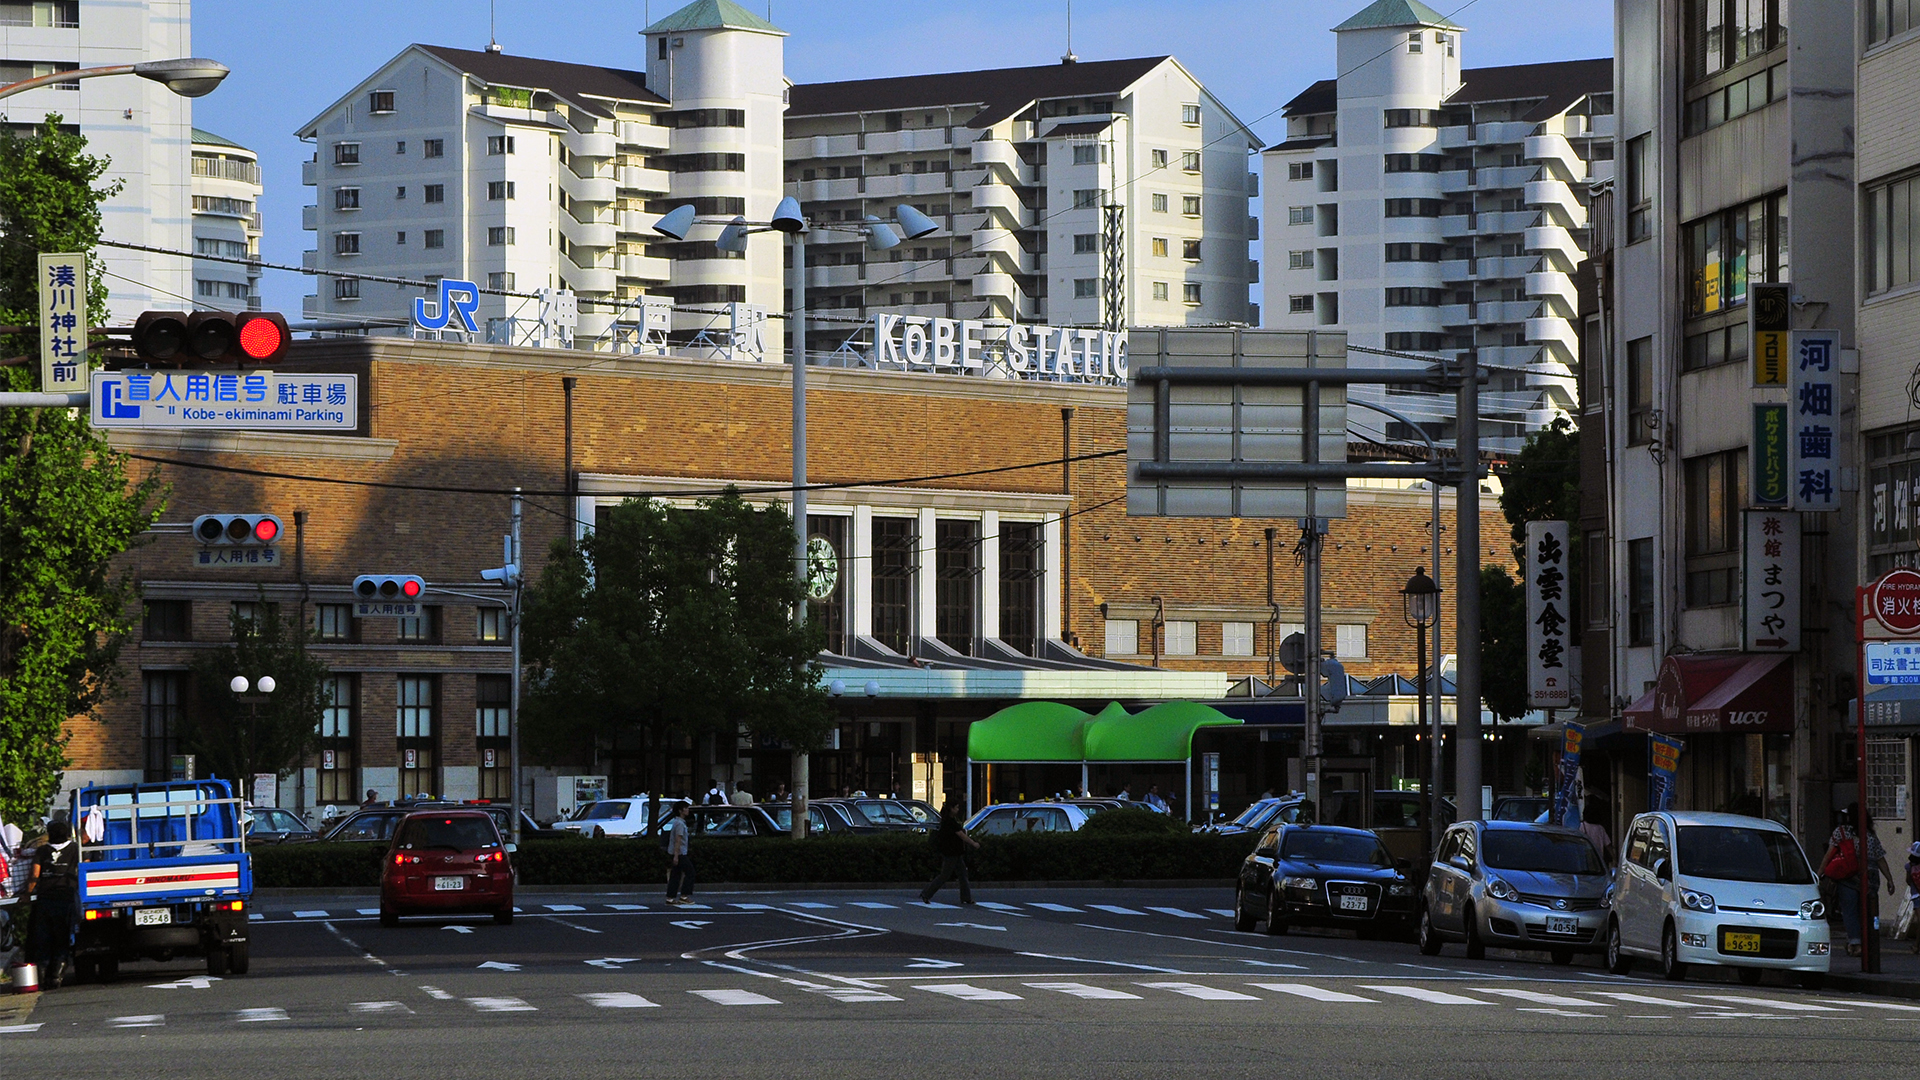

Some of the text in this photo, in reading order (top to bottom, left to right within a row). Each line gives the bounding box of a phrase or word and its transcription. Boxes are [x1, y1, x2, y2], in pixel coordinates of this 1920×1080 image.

[414, 279, 480, 333] JR
[48, 264, 78, 382] 湊川神社前
[539, 287, 767, 354] 神戸駅
[1765, 333, 1779, 383] プロミス
[126, 373, 268, 402] 盲人用信号
[277, 383, 347, 405] 駐車場
[183, 407, 292, 420] Kobe-ekiminami
[296, 409, 343, 423] Parking
[1799, 338, 1833, 503] 河畑歯科
[1765, 408, 1779, 496] ポケットバンク
[1873, 476, 1920, 532] 河畑
[198, 550, 275, 564] 盲人用信号
[1882, 583, 1896, 591] FIRE
[358, 604, 417, 615] 盲人用信号
[1535, 531, 1566, 669] 出雲食堂
[1871, 657, 1920, 671] 司法書士
[142, 913, 169, 924] 85-48
[1552, 923, 1576, 933] 40-58
[1732, 940, 1759, 951] 96-93
